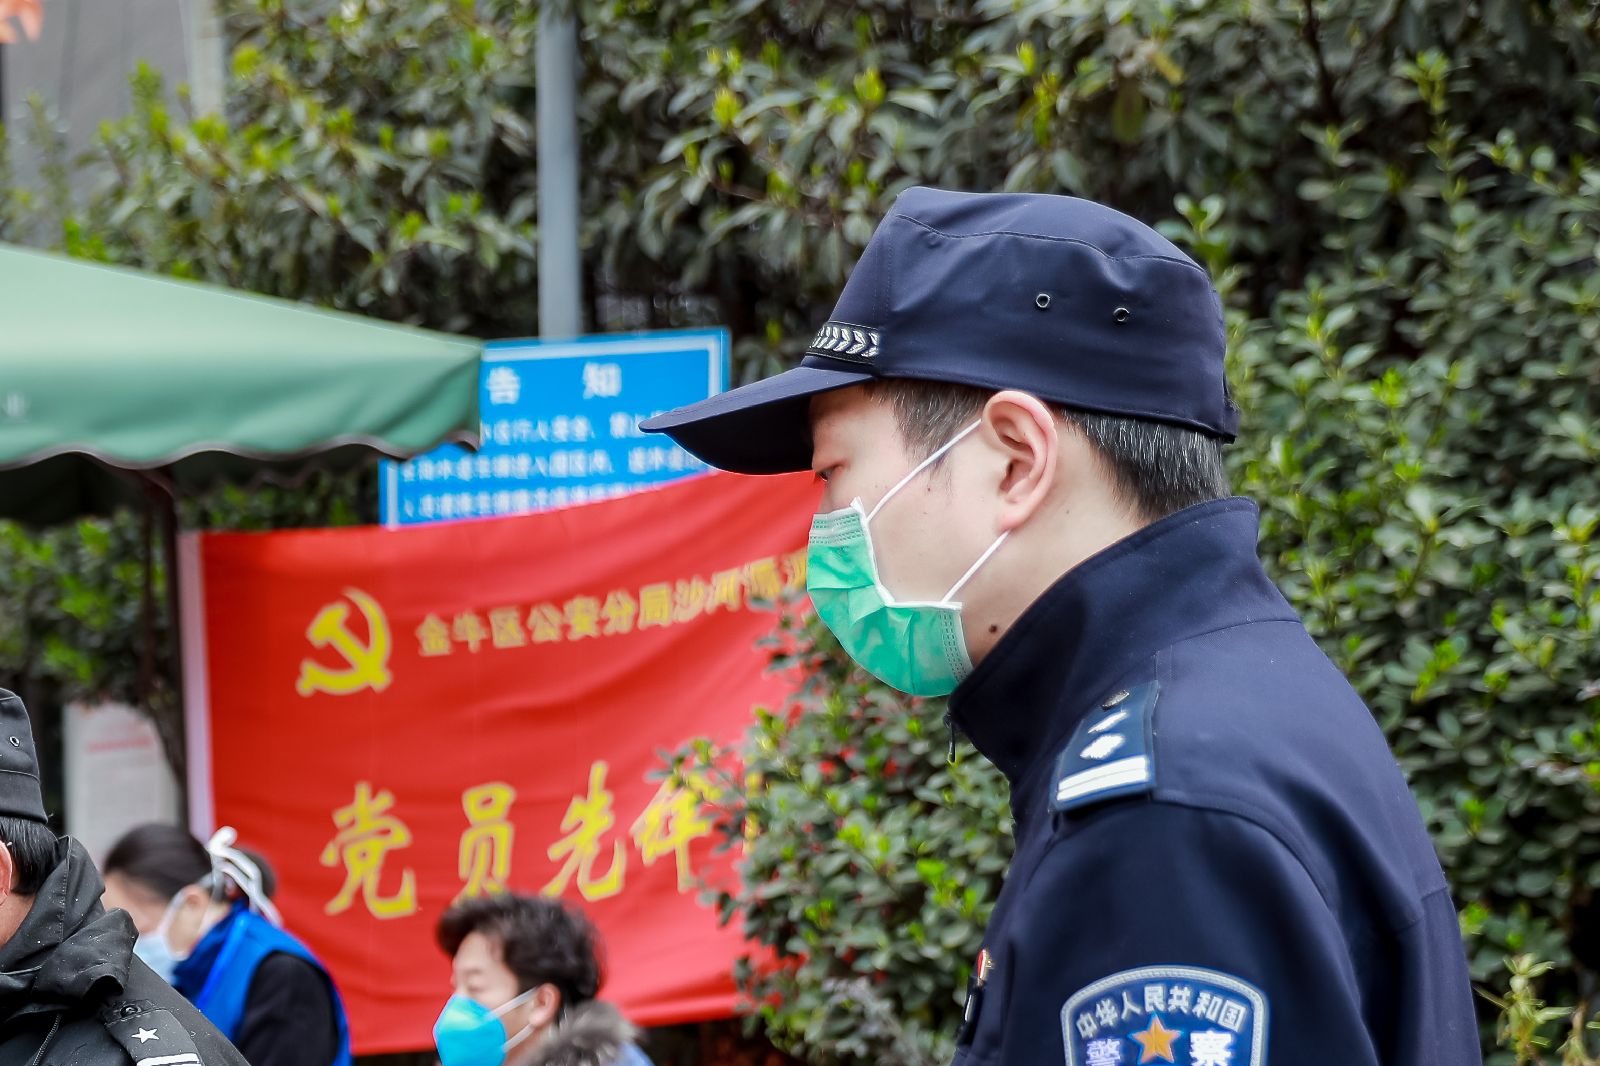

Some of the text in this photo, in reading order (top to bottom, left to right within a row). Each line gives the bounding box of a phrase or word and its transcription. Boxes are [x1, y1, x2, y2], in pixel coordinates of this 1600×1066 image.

[320, 761, 760, 920] 党员先锋
[1076, 985, 1247, 1039] 中华人民共和国
